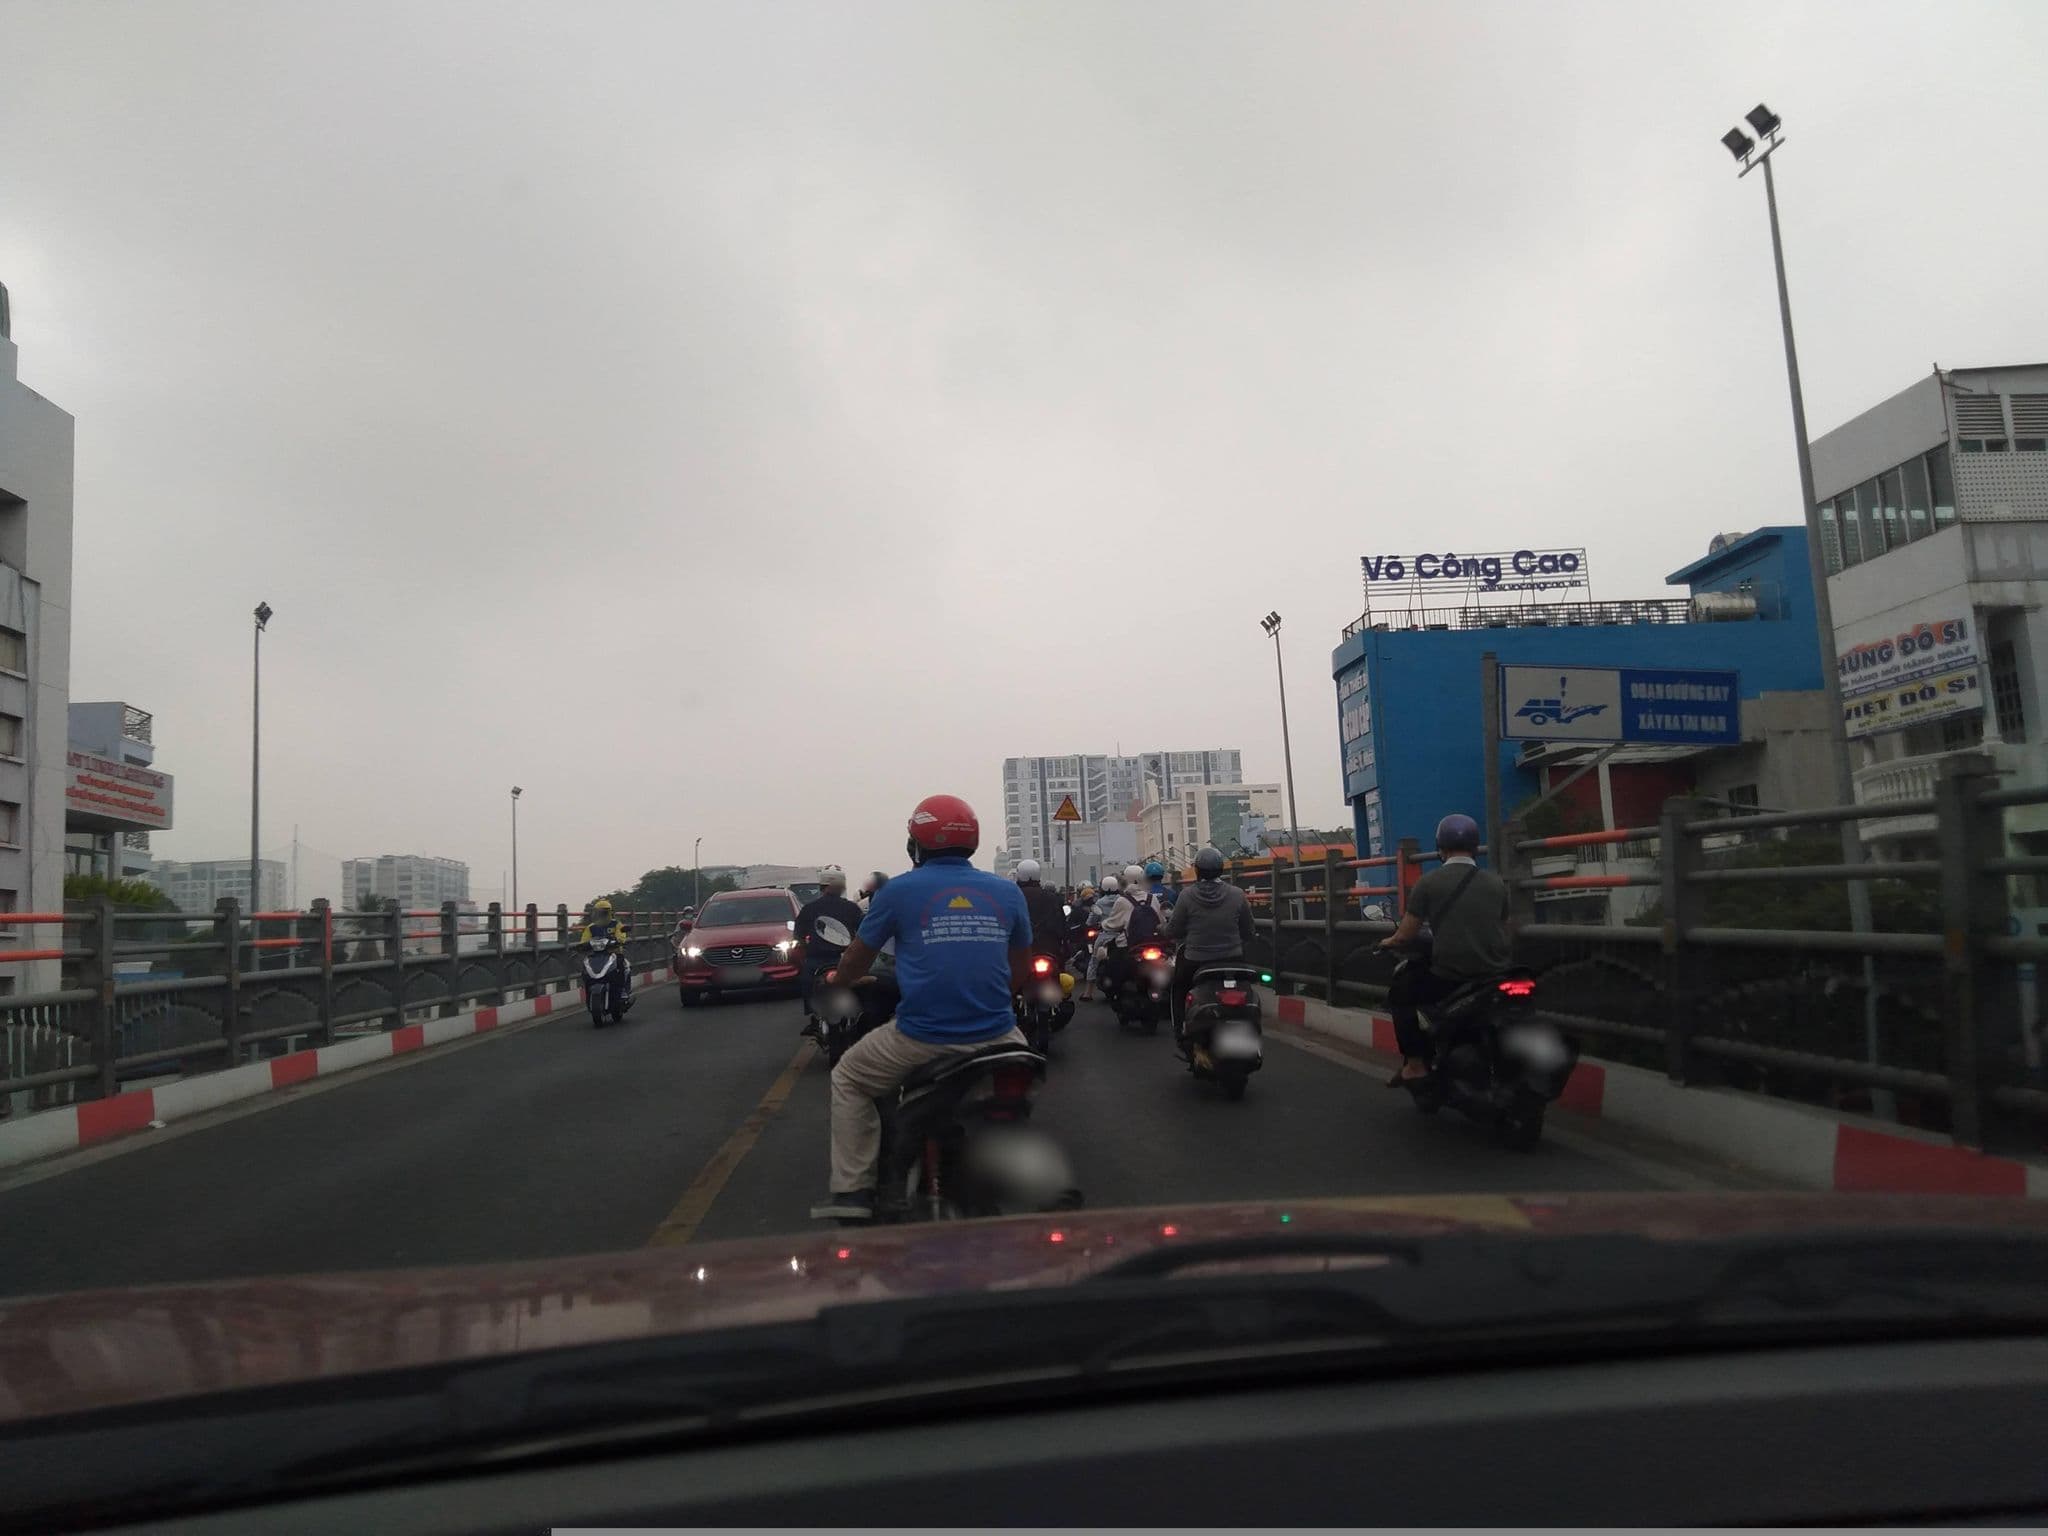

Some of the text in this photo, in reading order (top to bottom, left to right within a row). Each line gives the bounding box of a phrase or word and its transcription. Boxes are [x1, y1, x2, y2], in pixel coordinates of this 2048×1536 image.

[1361, 549, 1580, 586] Võ Công Cao
